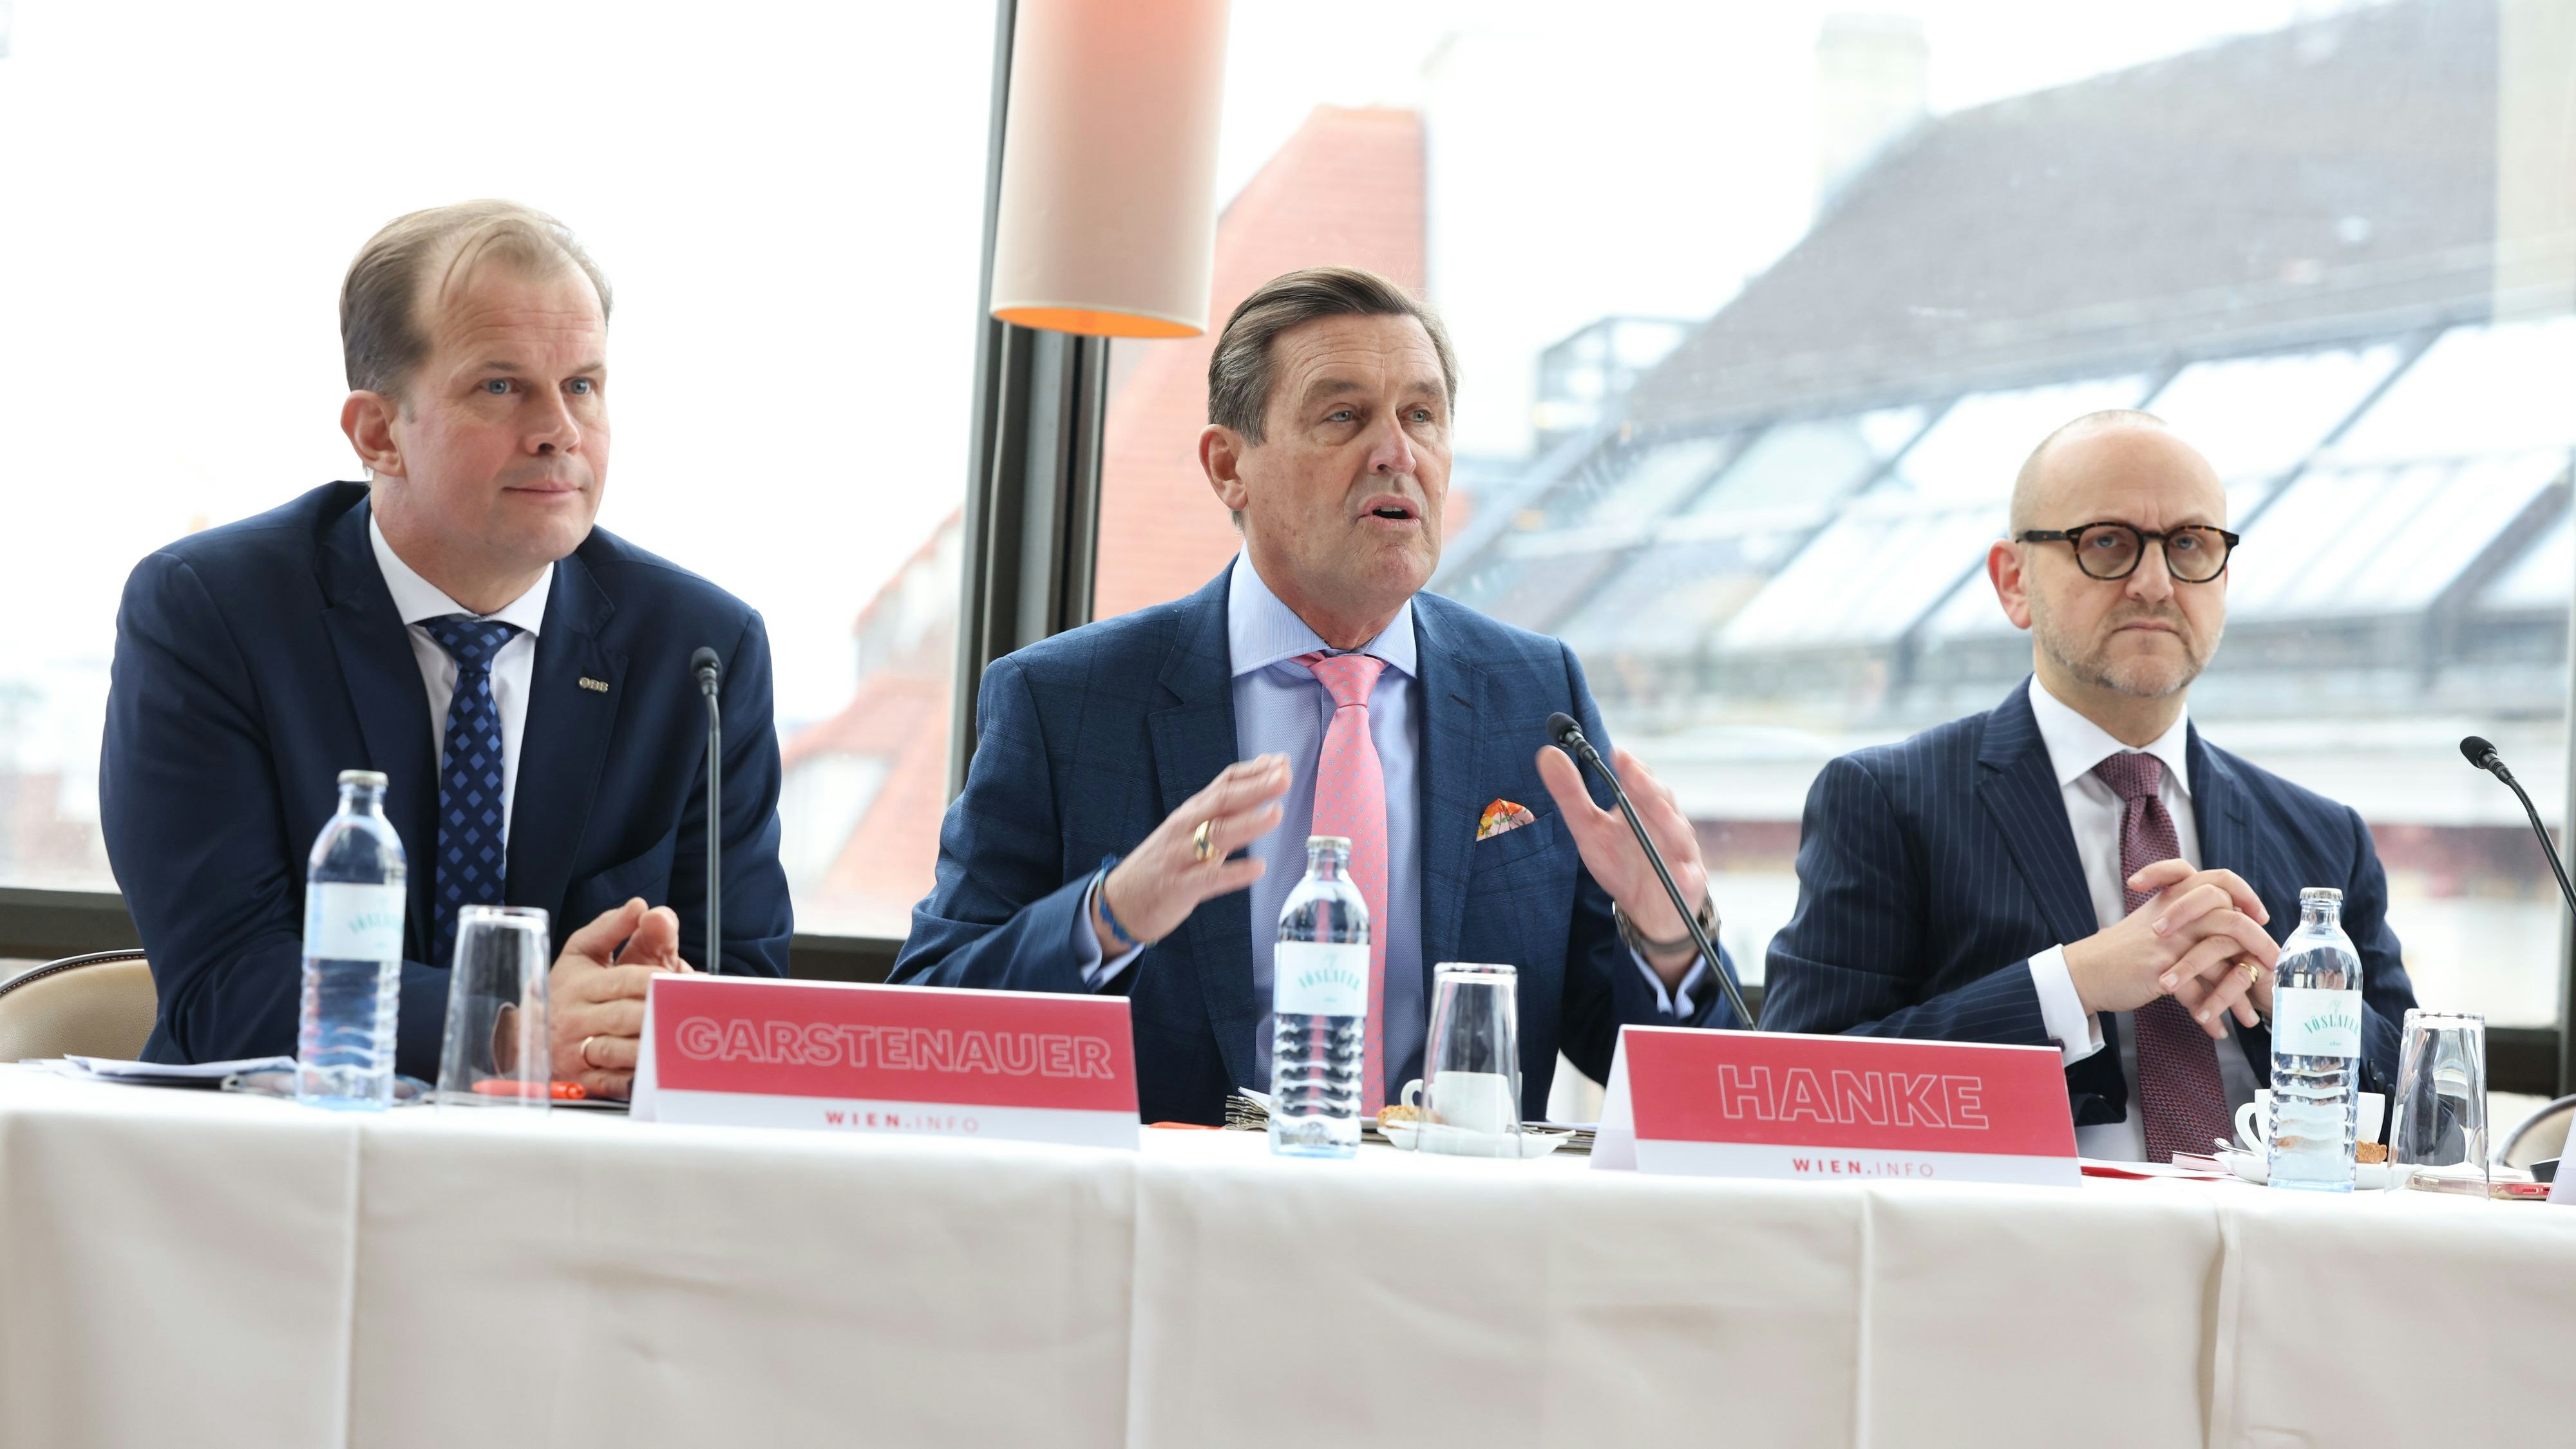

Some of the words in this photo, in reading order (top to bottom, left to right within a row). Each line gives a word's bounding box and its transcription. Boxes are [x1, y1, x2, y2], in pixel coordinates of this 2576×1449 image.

[676, 1016, 1113, 1079] GARSTENAUER
[1718, 1064, 1989, 1129] HANKE
[825, 1110, 979, 1133] WIEN.INFO
[1793, 1159, 1933, 1178] WIEN.INFO
